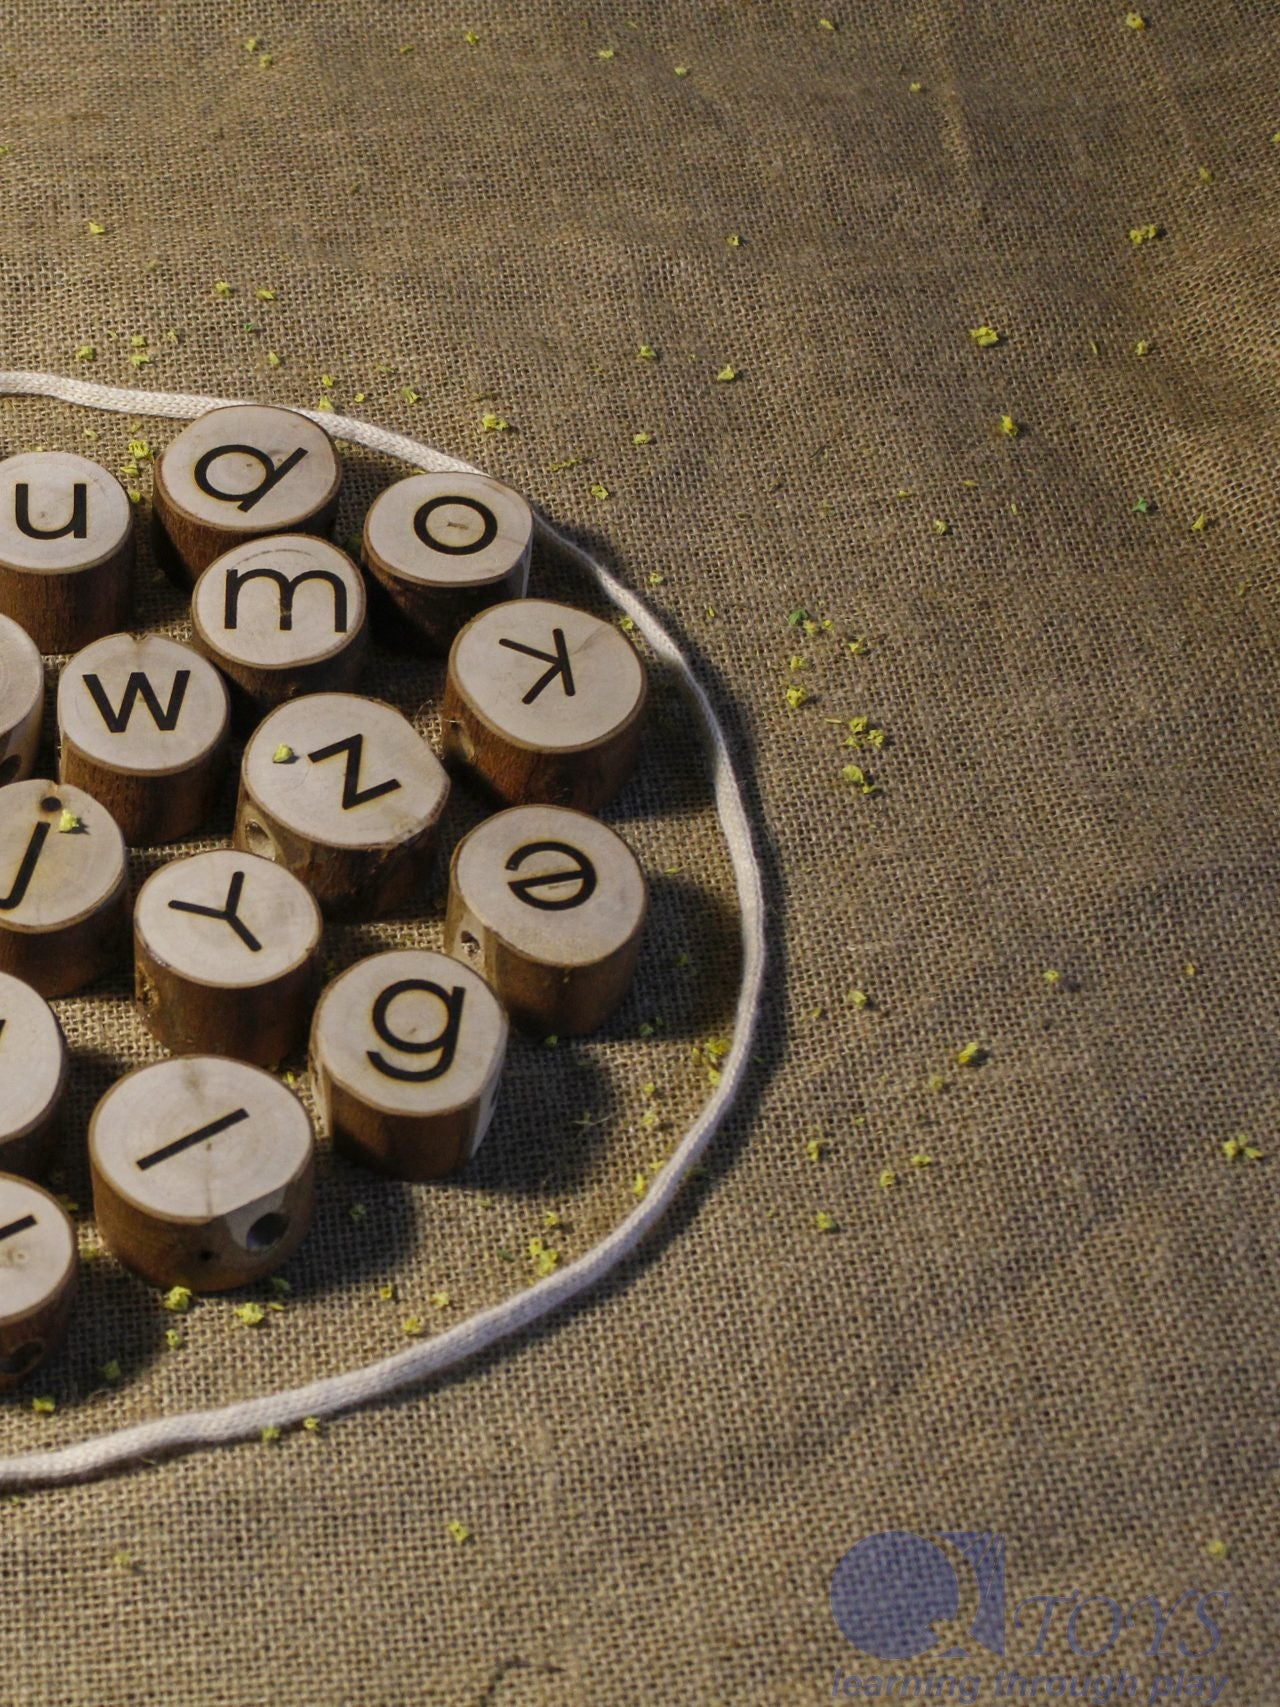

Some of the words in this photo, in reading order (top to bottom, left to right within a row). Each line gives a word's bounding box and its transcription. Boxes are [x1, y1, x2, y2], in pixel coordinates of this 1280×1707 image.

[15, 483, 87, 540] u
[224, 568, 348, 633] m
[504, 840, 598, 912] e
[366, 978, 466, 1083] g
